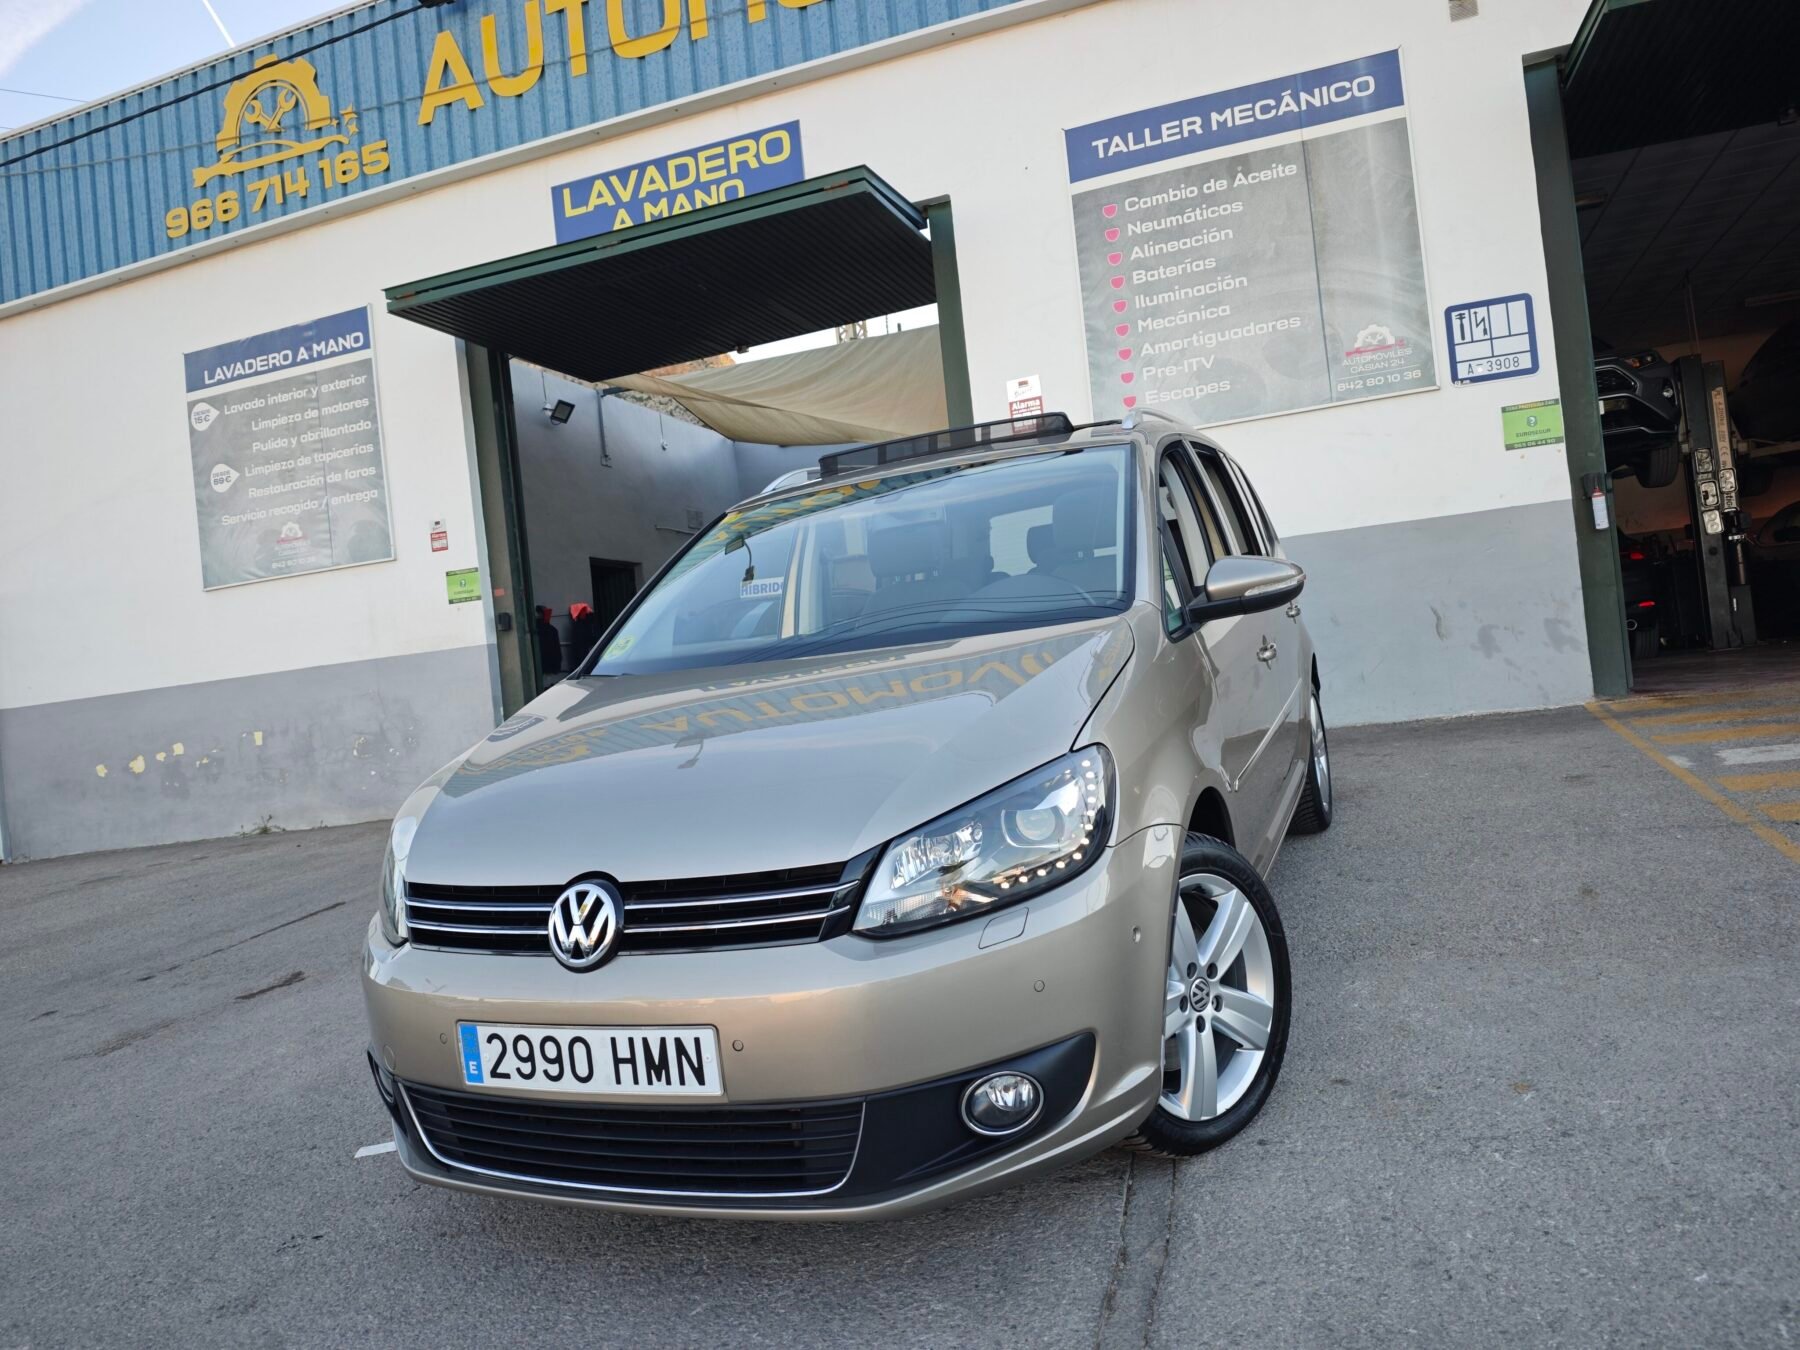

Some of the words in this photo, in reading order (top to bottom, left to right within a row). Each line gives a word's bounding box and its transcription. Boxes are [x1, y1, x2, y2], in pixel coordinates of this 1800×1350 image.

[418, 0, 825, 126] AUTO
[1092, 116, 1203, 159] TALLER
[1211, 75, 1376, 131] MECÁNICO
[165, 190, 240, 238] 966
[247, 166, 310, 213] 714
[318, 139, 390, 189] 165
[563, 129, 791, 218] LAVADERO
[1124, 184, 1198, 212] Cambio
[1203, 178, 1227, 194] de
[1233, 163, 1297, 188] Aceite
[612, 208, 634, 231] A
[643, 178, 745, 223] MANO
[1127, 201, 1243, 236] Neumáticos
[1130, 228, 1233, 261] Alineación
[1132, 257, 1217, 285] Baterías
[1135, 275, 1248, 309] Iluminación
[1137, 304, 1231, 333] Mecánica
[1140, 316, 1301, 357] Amortiguadores
[204, 349, 292, 385] LAVADERO
[296, 346, 309, 362] A
[312, 331, 364, 358] MANO
[1142, 355, 1215, 381] Pre-ITV
[224, 398, 266, 415] Lavado
[267, 386, 309, 406] interior
[310, 386, 318, 399] y
[321, 373, 367, 393] exterior
[1144, 380, 1231, 405] Escapes
[1366, 376, 1385, 386] 80
[1386, 373, 1401, 383] 10
[252, 409, 301, 431] Limpieza
[304, 406, 319, 419] de
[321, 397, 369, 416] motores
[252, 436, 288, 453] Pulido
[291, 436, 297, 448] y
[300, 419, 372, 443] abrillantado
[245, 459, 294, 477] Limpieza
[296, 455, 312, 467] de
[314, 442, 374, 464] tapicerías
[249, 472, 324, 498] Restauración
[326, 471, 342, 483] de
[221, 509, 266, 526] Servicio
[268, 496, 318, 517] recogida
[331, 489, 378, 506] entrega
[468, 1061, 478, 1074] E
[486, 1032, 594, 1084] 2990
[610, 1036, 706, 1086] HMN
